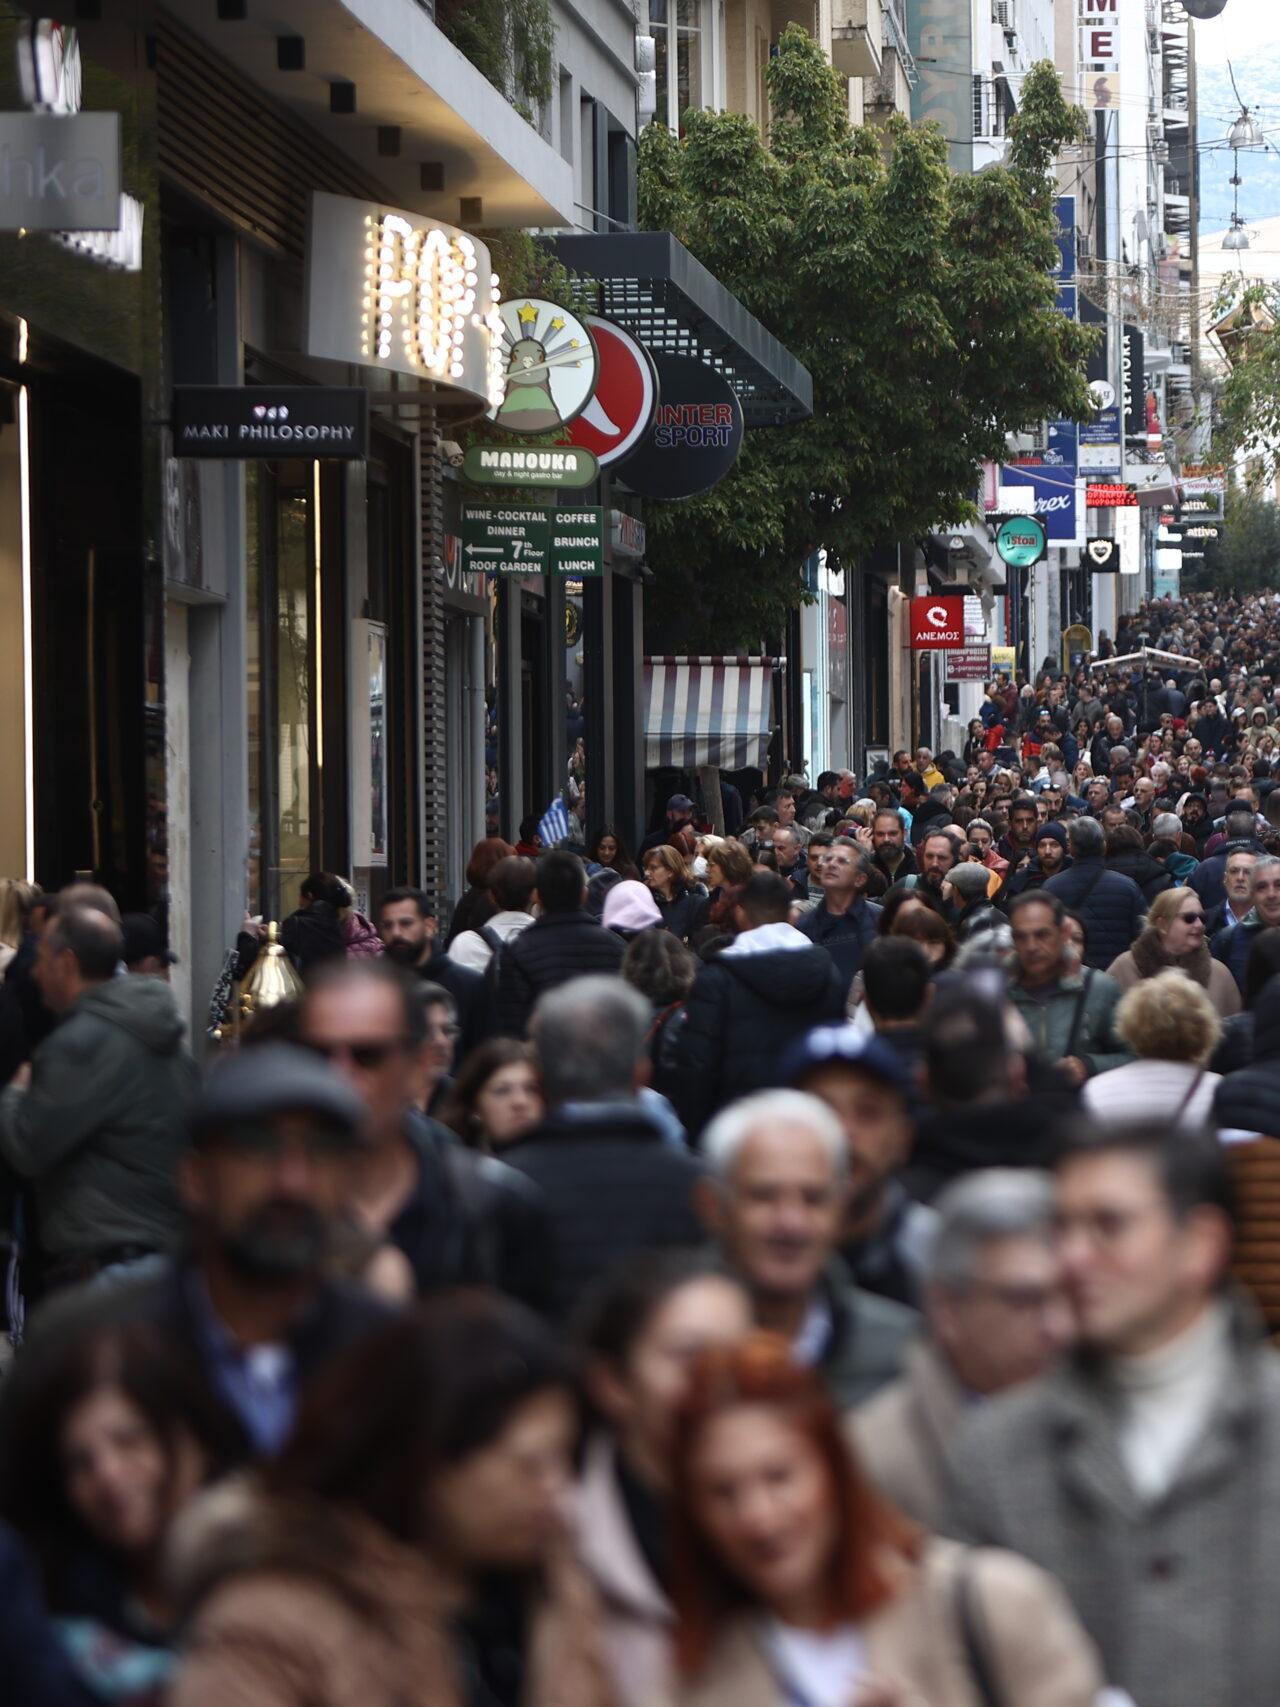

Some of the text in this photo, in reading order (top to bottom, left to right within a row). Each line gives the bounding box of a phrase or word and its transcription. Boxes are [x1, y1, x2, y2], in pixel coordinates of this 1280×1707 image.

[1121, 334, 1133, 415] SEPHORA
[655, 404, 732, 425] INTER
[184, 424, 354, 440] MAKI PHILOSOPHY
[655, 425, 733, 447] SPORT
[480, 451, 577, 471] MANOUKA
[513, 471, 530, 480] night
[552, 472, 563, 480] bar
[556, 513, 597, 524] COFFEE
[487, 526, 526, 536] DINNER
[554, 537, 599, 547] BRUNCH
[523, 549, 545, 558] Floor
[469, 561, 541, 572] ROOF GARDEN
[558, 560, 595, 570] LUNCH
[916, 631, 960, 640] ΑΝΕΜΟΣ
